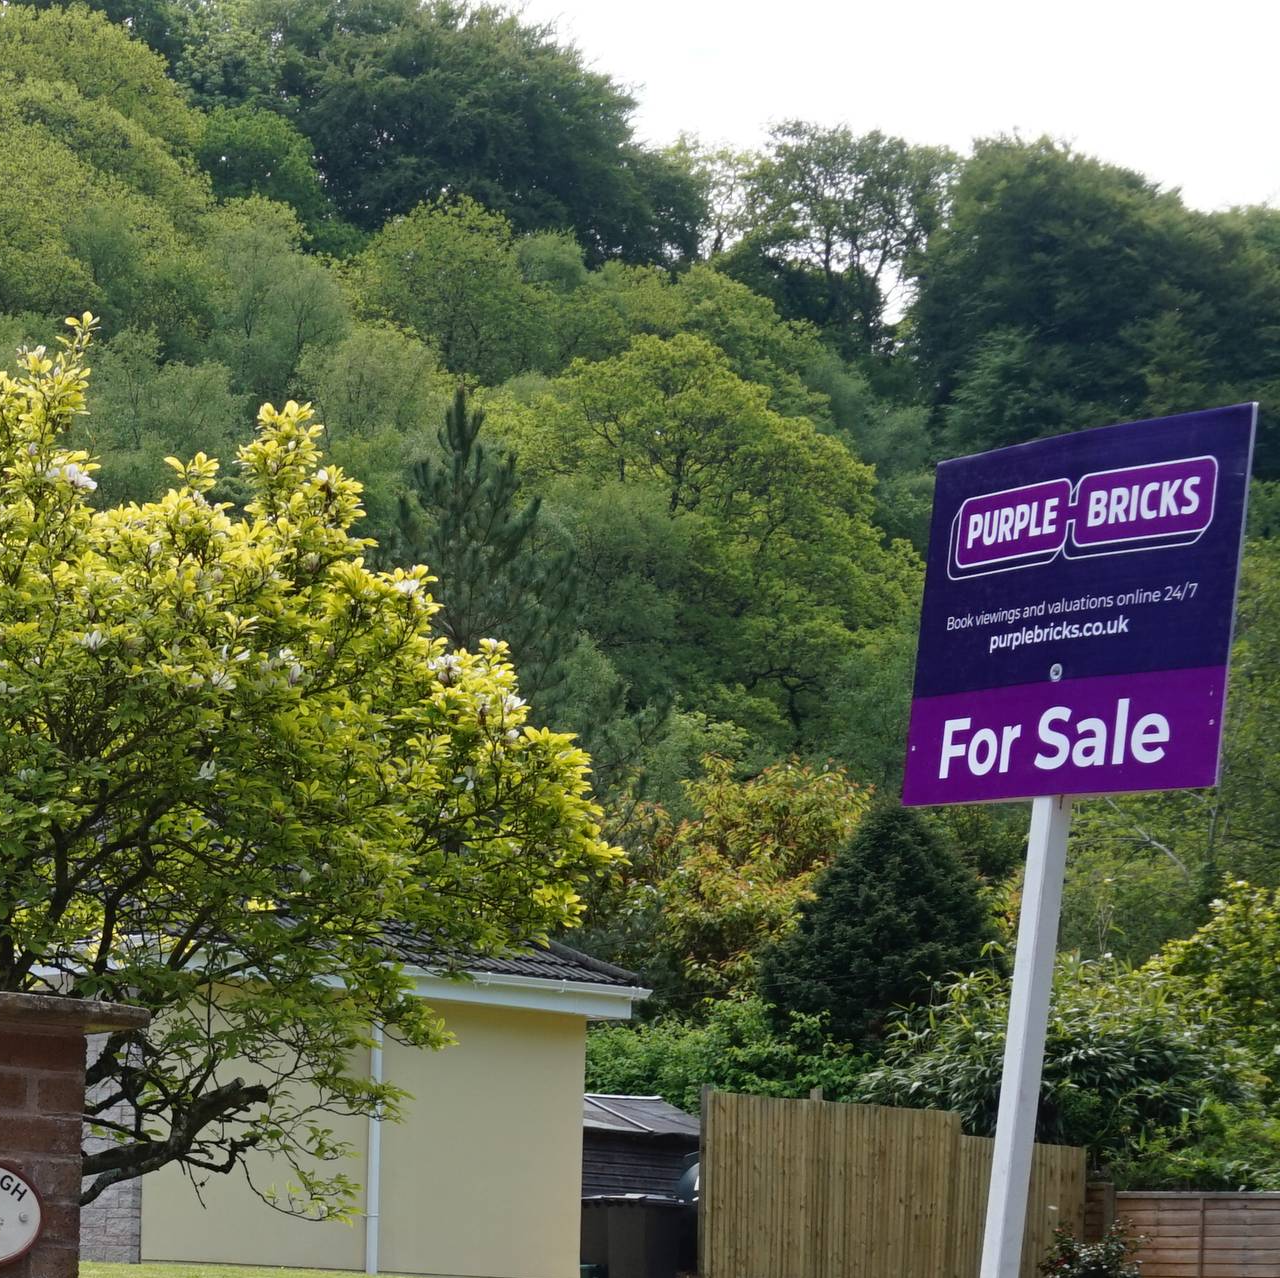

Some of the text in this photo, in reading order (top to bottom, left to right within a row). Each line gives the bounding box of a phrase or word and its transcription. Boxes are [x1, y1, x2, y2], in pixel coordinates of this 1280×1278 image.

[966, 476, 1201, 549] PURPLE BRICKS
[946, 582, 1199, 631] Book viewings and valuations online 24/7
[989, 616, 1129, 653] purplebricks.co.uk
[938, 697, 1170, 779] For Sale
